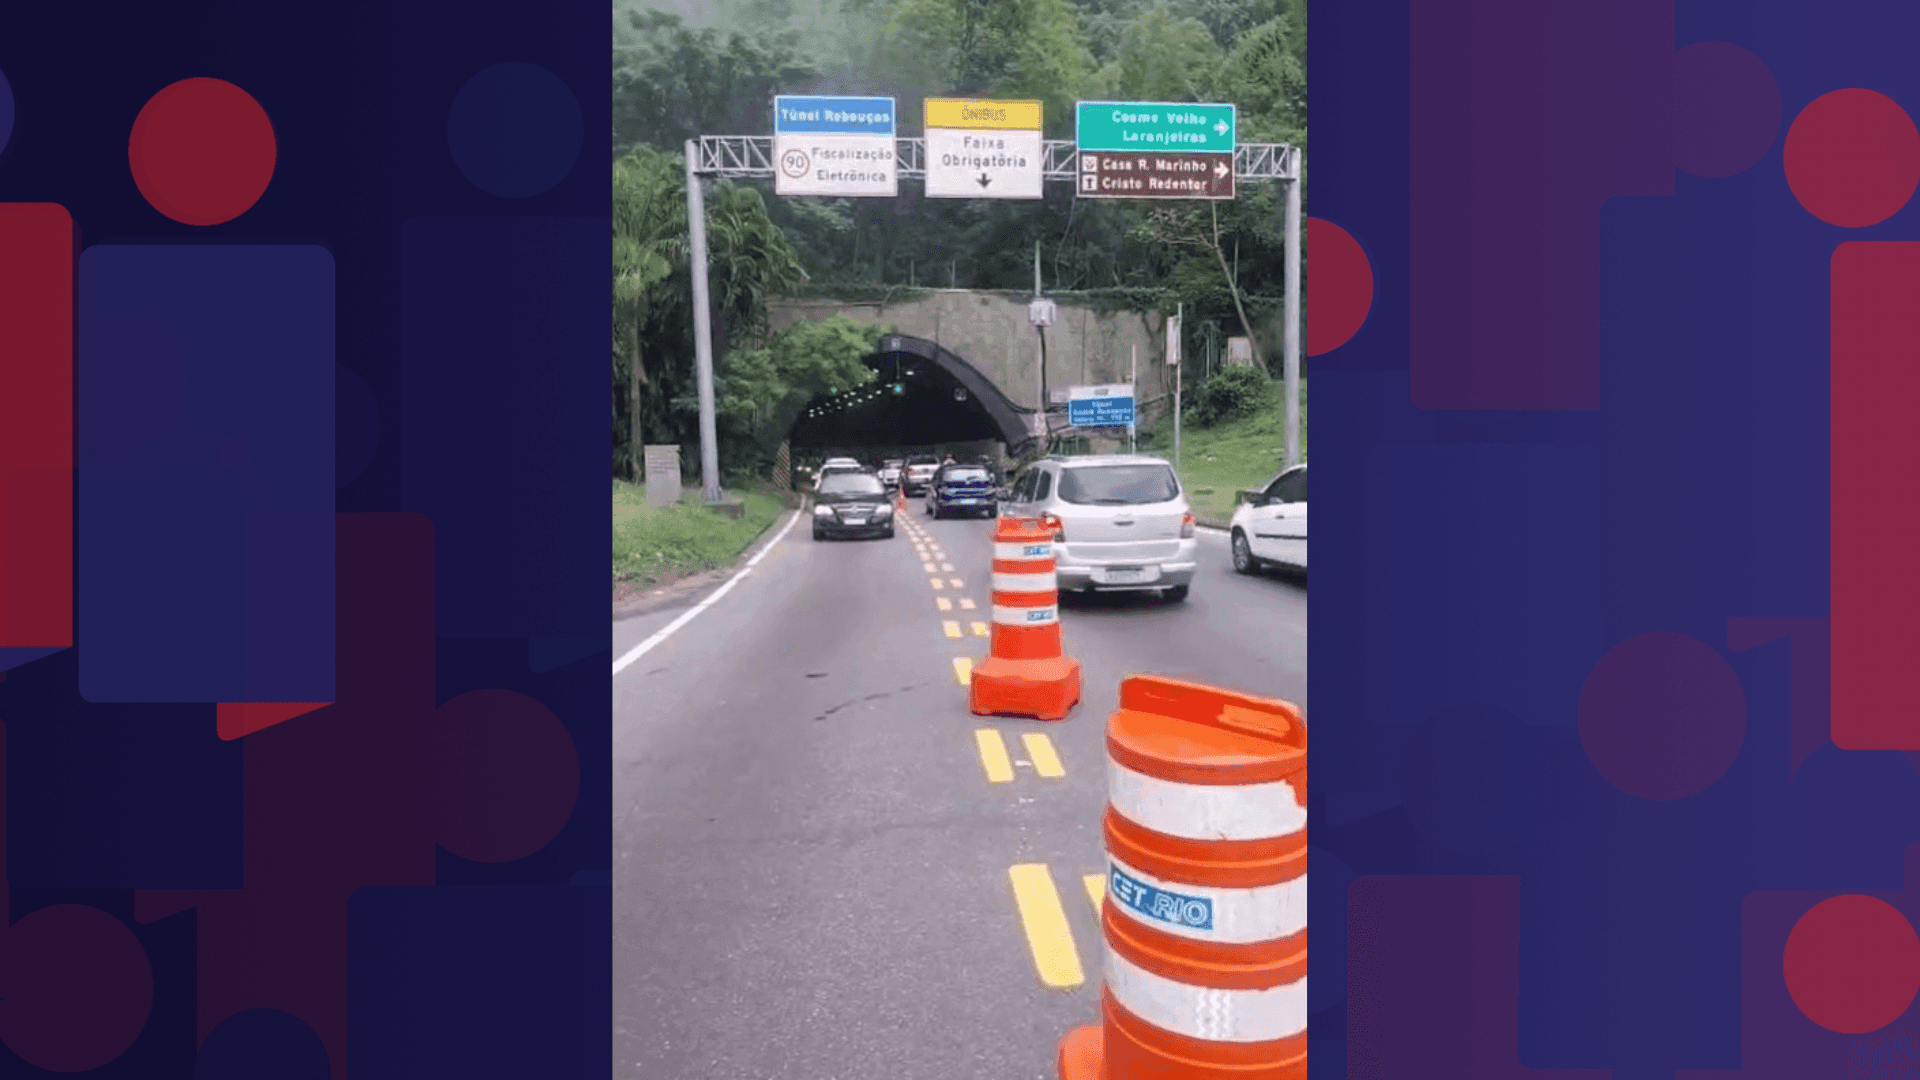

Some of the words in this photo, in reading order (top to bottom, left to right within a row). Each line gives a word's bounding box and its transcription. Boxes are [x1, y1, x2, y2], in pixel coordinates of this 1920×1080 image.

[781, 108, 819, 121] Túnel
[824, 110, 890, 125] Rebouças
[1112, 110, 1158, 124] Cosme
[1167, 112, 1207, 125] Velho
[963, 136, 1004, 149] Faixa
[1123, 130, 1207, 145] Laranjeiras
[812, 147, 892, 162] Fiscalização
[942, 153, 1026, 169] Obrigatória
[787, 156, 804, 169] 90
[1102, 158, 1132, 171] Casa
[1138, 159, 1150, 171] R.
[1156, 159, 1207, 172] Marinho
[817, 169, 887, 182] Eletrônica
[1102, 177, 1143, 190] Cristo
[1149, 178, 1208, 190] Redentor
[1113, 871, 1148, 907] CET
[1153, 893, 1208, 926] RIO
